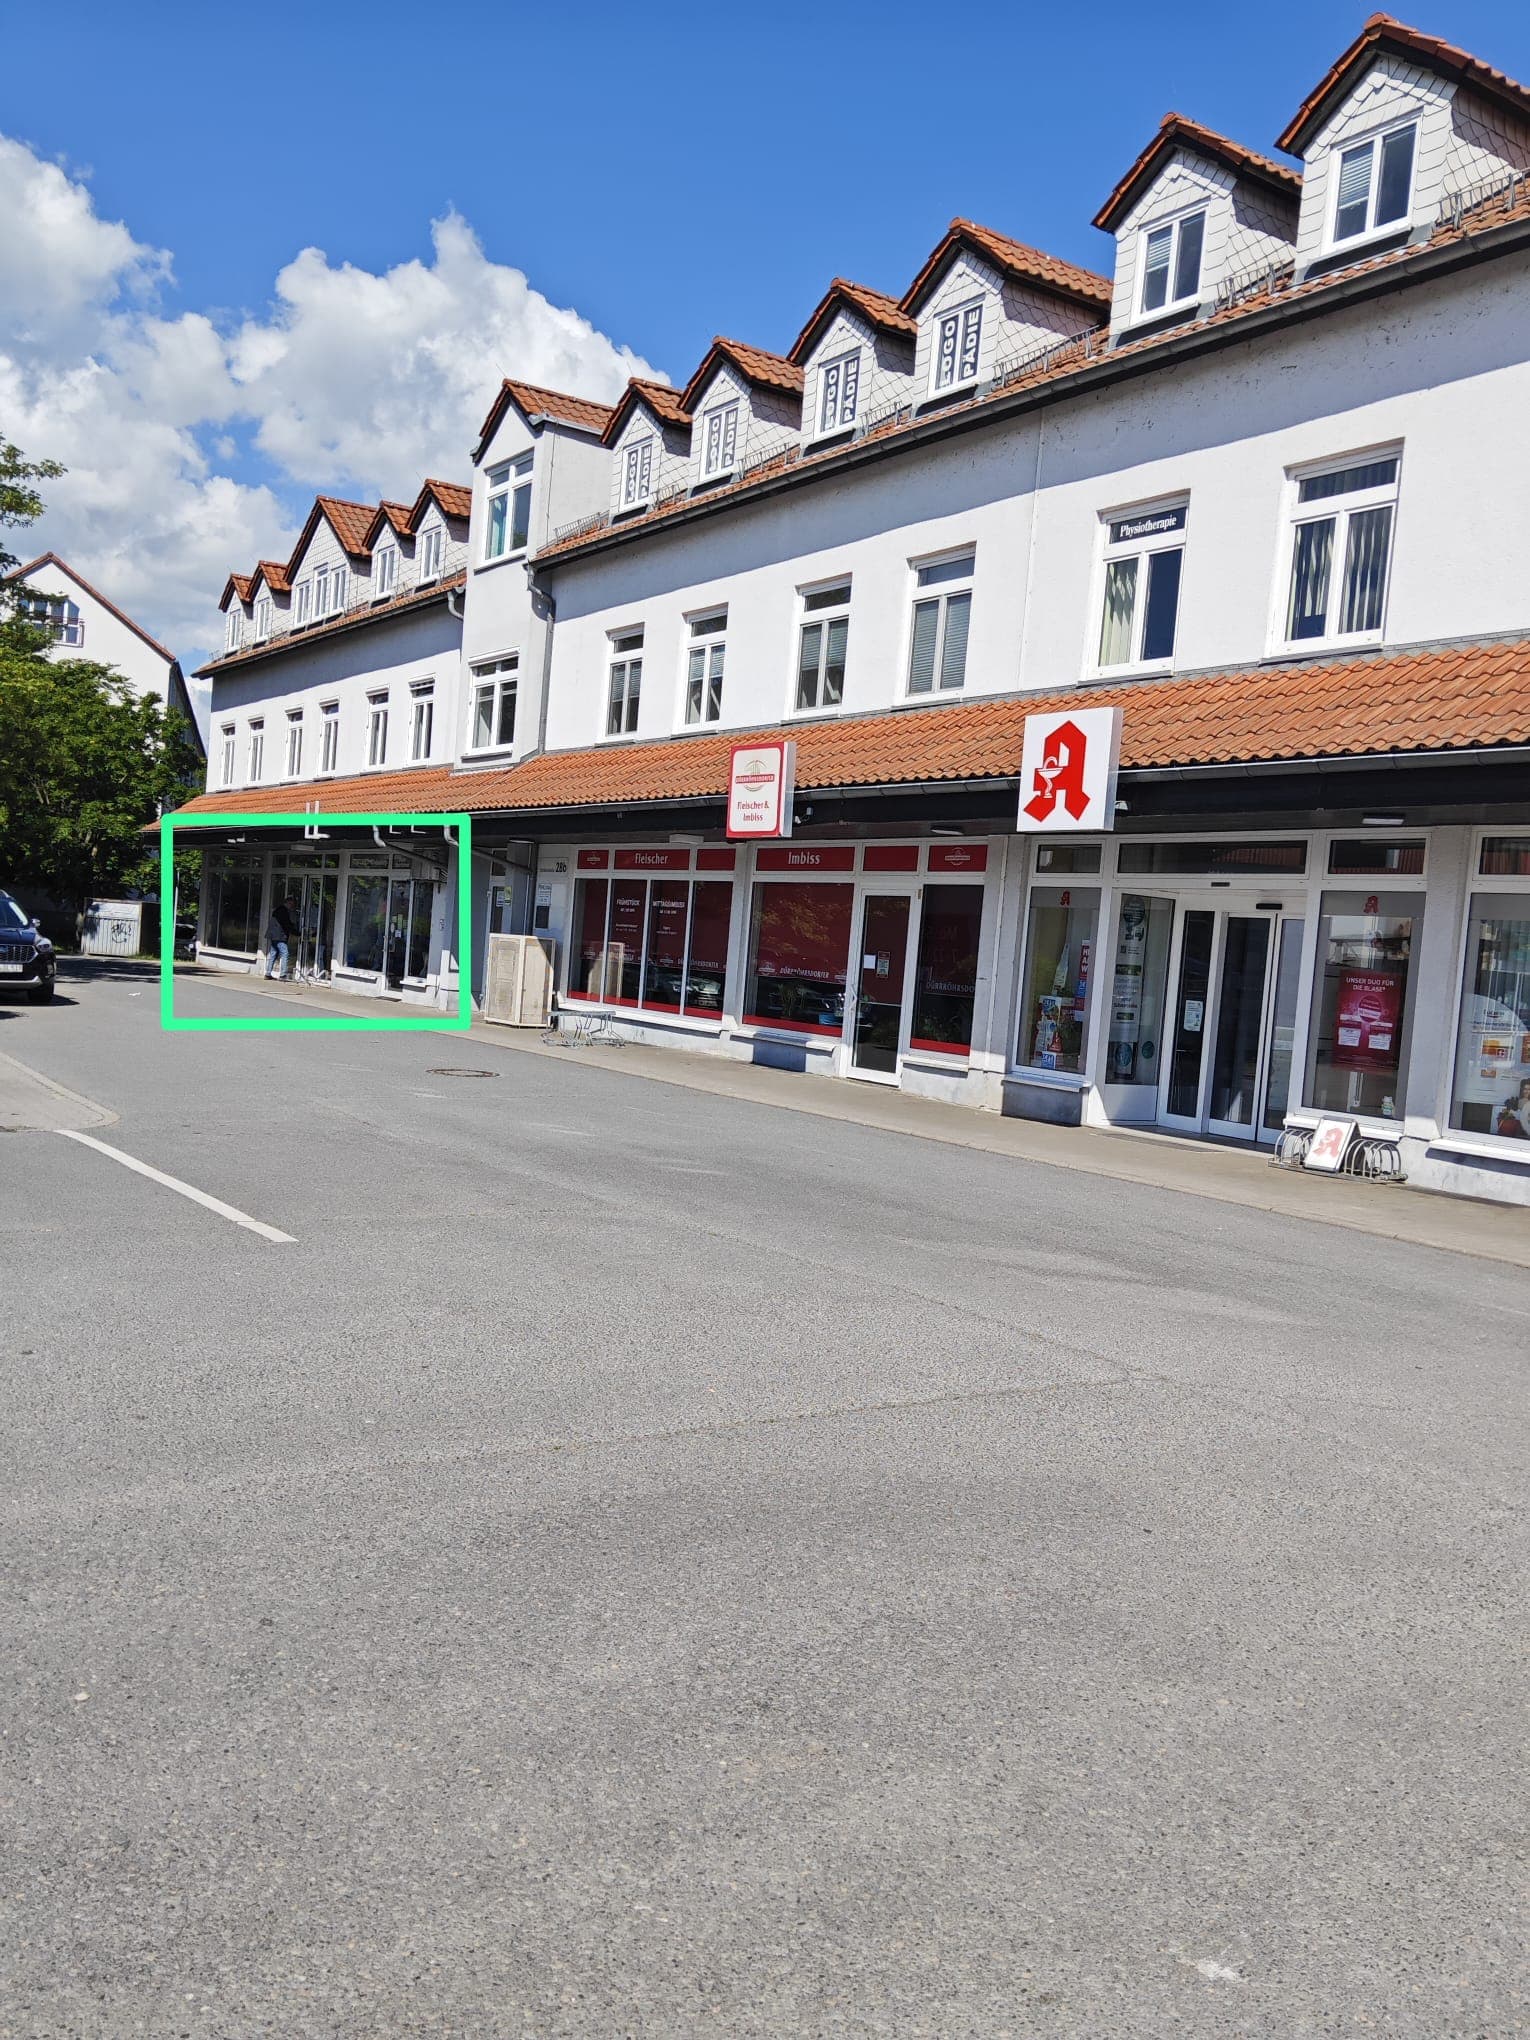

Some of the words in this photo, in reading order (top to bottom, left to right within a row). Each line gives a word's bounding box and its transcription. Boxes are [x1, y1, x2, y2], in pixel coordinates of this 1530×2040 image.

[939, 320, 956, 387] LOGO
[825, 369, 837, 431] LOGO
[1119, 514, 1177, 538] Physiotherapie
[737, 801, 763, 810] Fleischer
[743, 813, 763, 822] Imbiss
[634, 852, 669, 864] Fleischer
[788, 851, 820, 865] Imbiss
[1346, 977, 1367, 985] UNSER
[1368, 978, 1381, 986] DUO
[1382, 978, 1395, 987] FÜR
